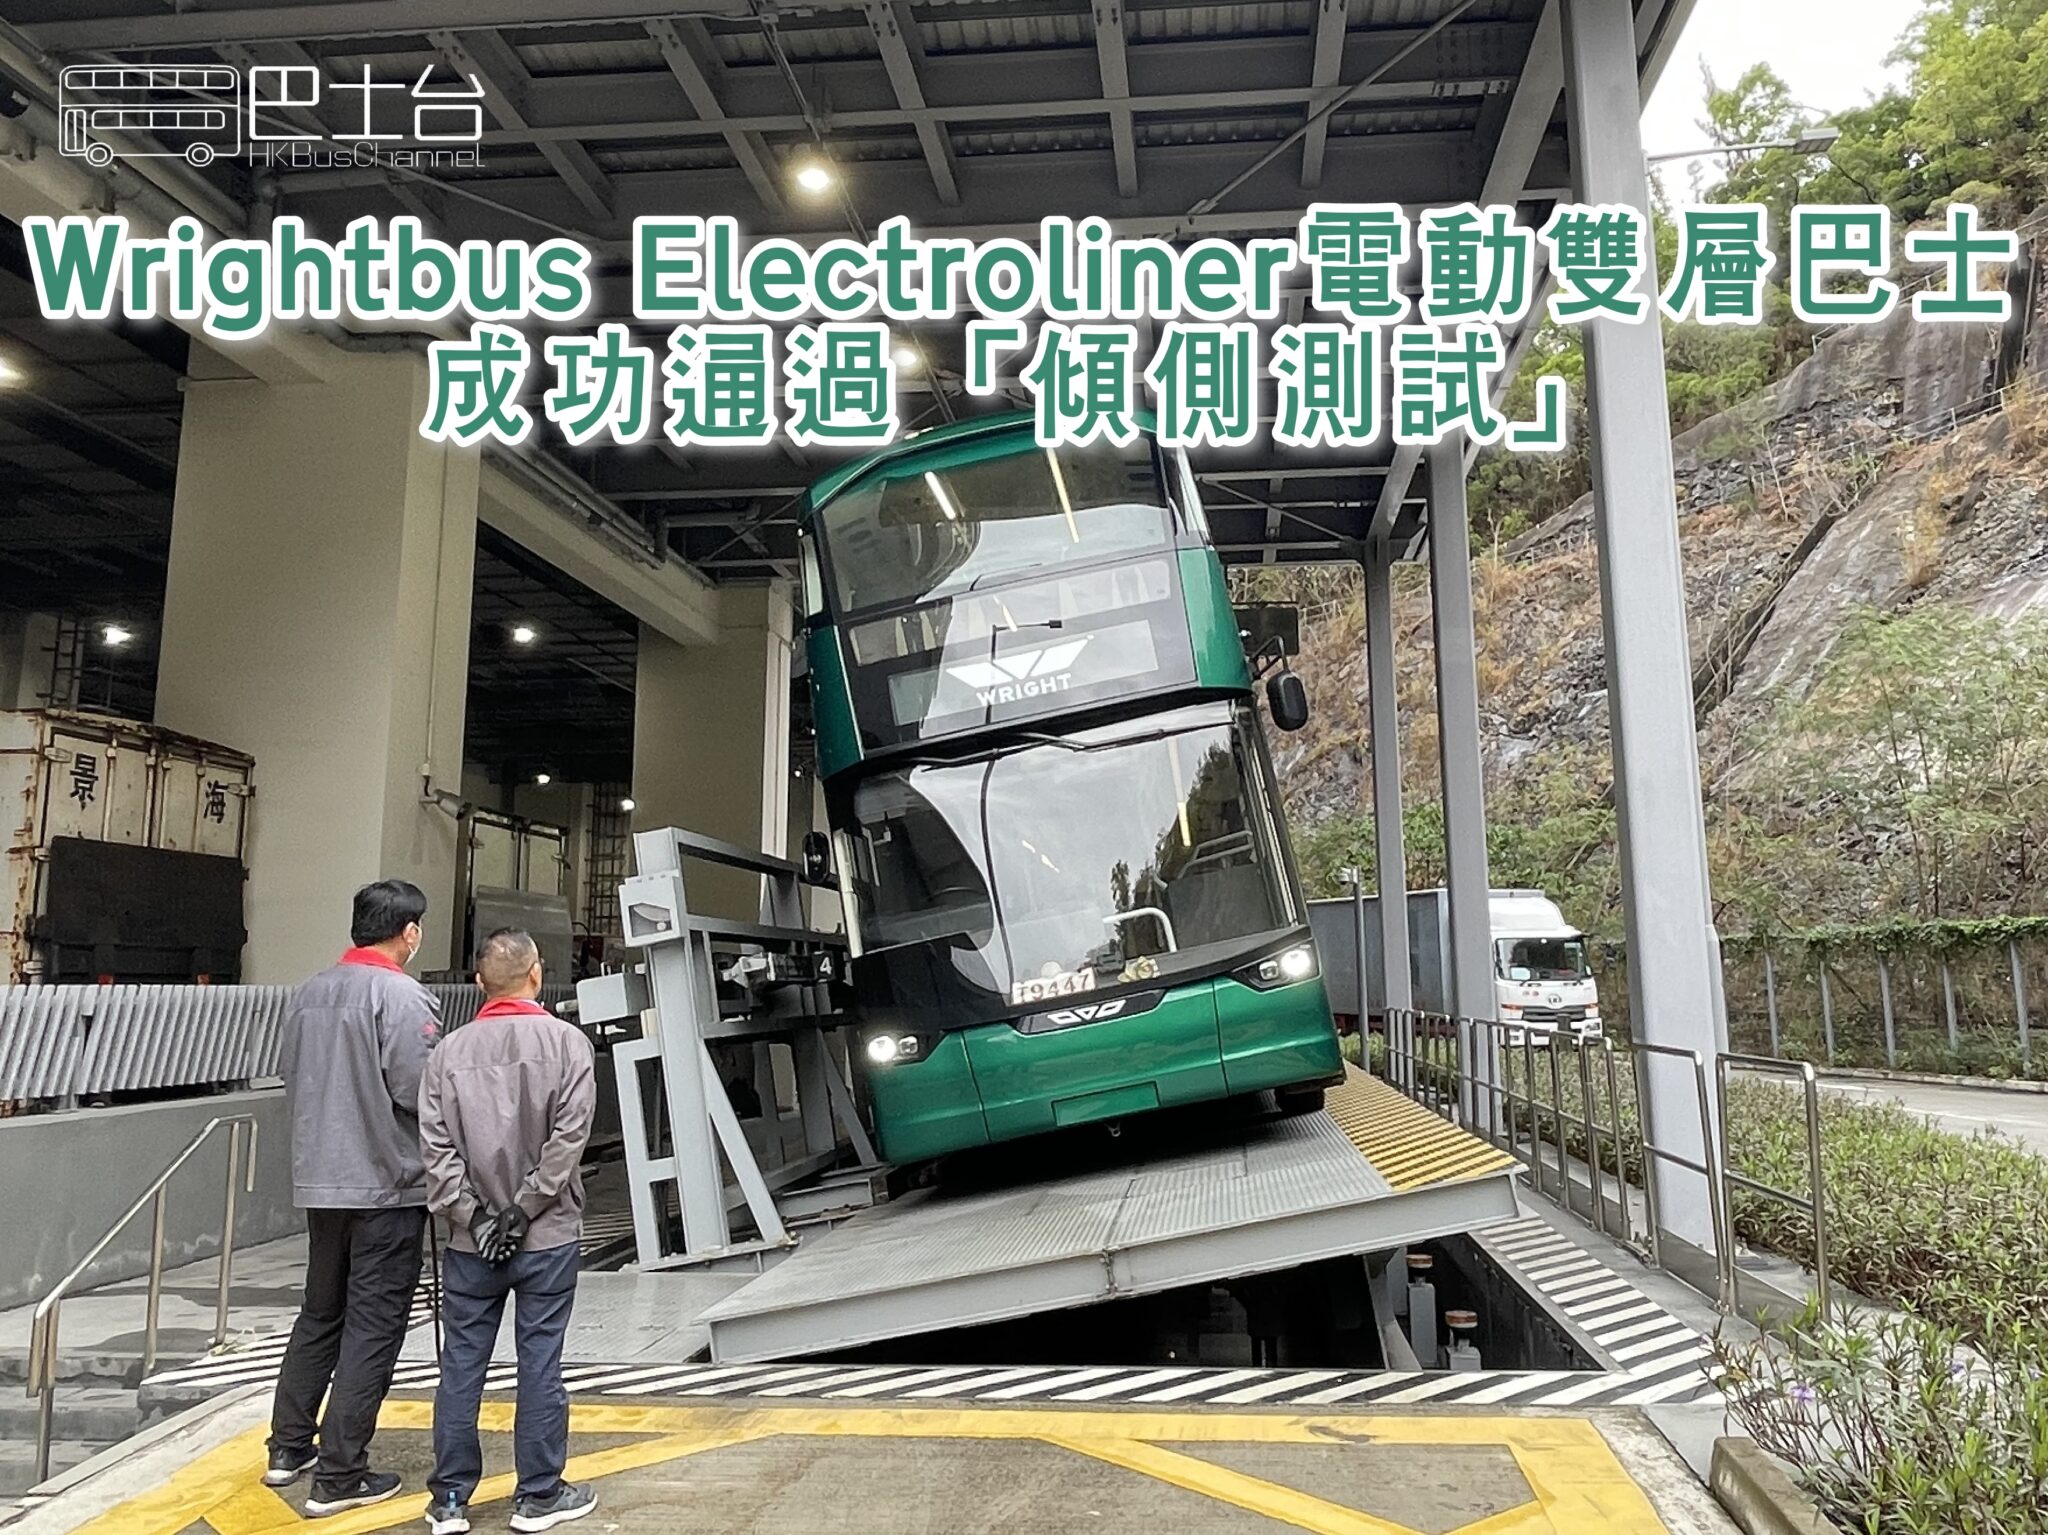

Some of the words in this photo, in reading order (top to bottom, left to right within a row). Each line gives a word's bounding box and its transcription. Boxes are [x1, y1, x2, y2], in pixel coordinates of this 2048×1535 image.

[976, 672, 1072, 707] WRIGHT
[69, 753, 99, 801] 景
[203, 780, 229, 824] 海
[819, 956, 832, 975] 4
